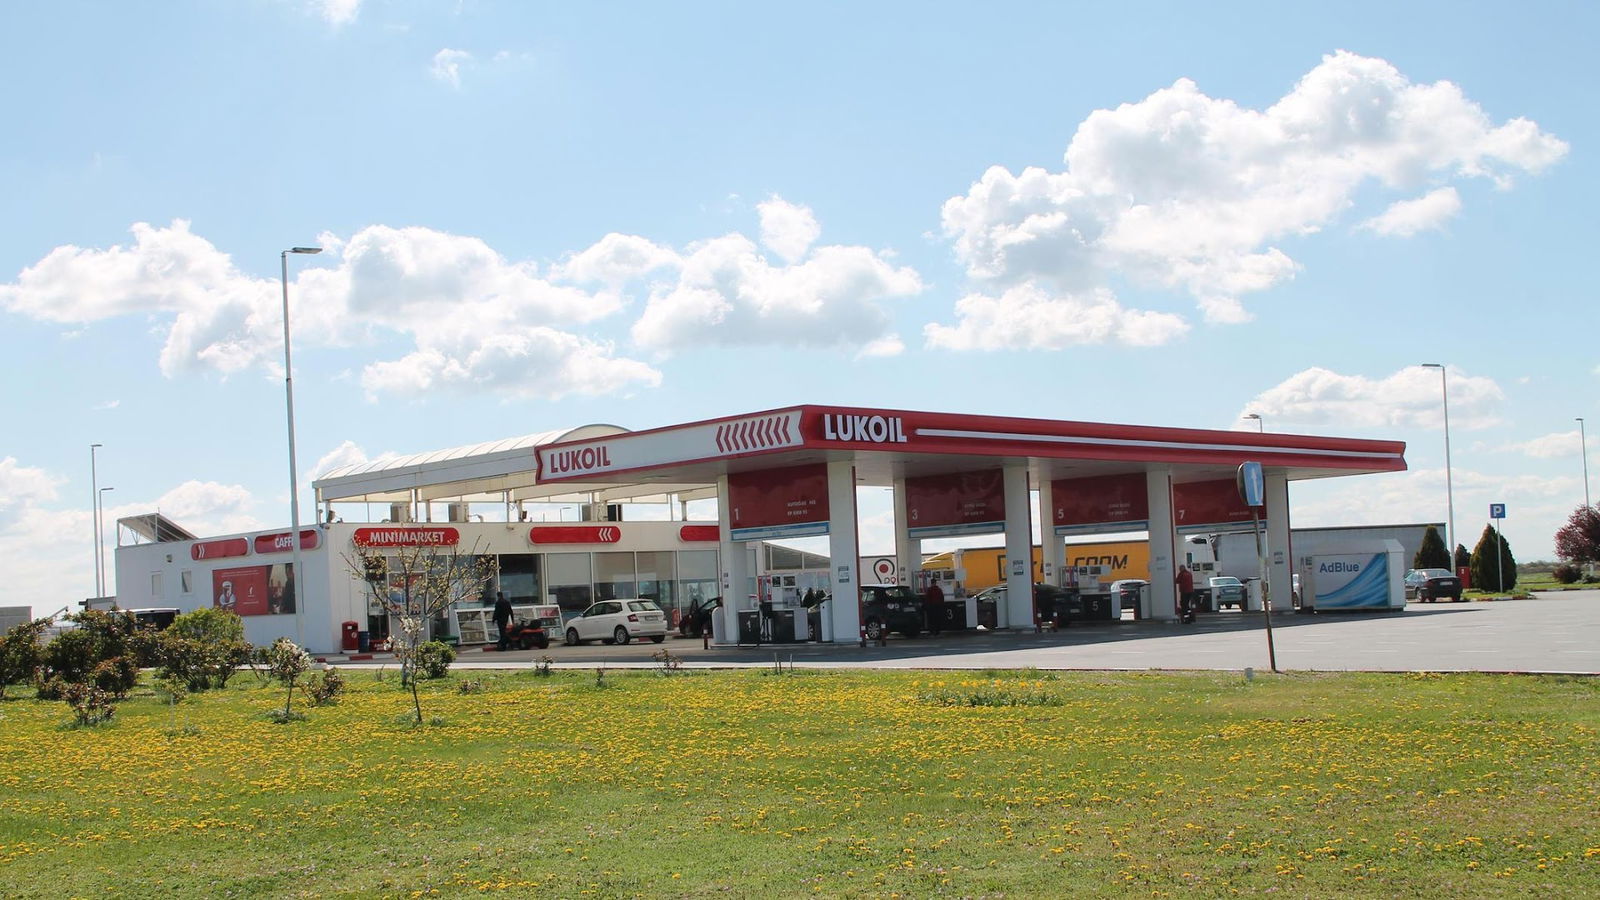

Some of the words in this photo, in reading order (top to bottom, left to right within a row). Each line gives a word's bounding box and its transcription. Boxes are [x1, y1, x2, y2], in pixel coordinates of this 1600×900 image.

[824, 414, 907, 443] LUKOIL
[550, 446, 611, 473] LUKOIL
[734, 507, 739, 520] 1
[911, 508, 918, 520] 3
[1057, 508, 1065, 519] 5
[1178, 509, 1185, 520] 7
[369, 531, 446, 543] MINIMARKET
[1319, 561, 1360, 573] AdBlue
[1091, 600, 1099, 611] 5
[946, 608, 954, 620] 3
[746, 620, 752, 632] 1
